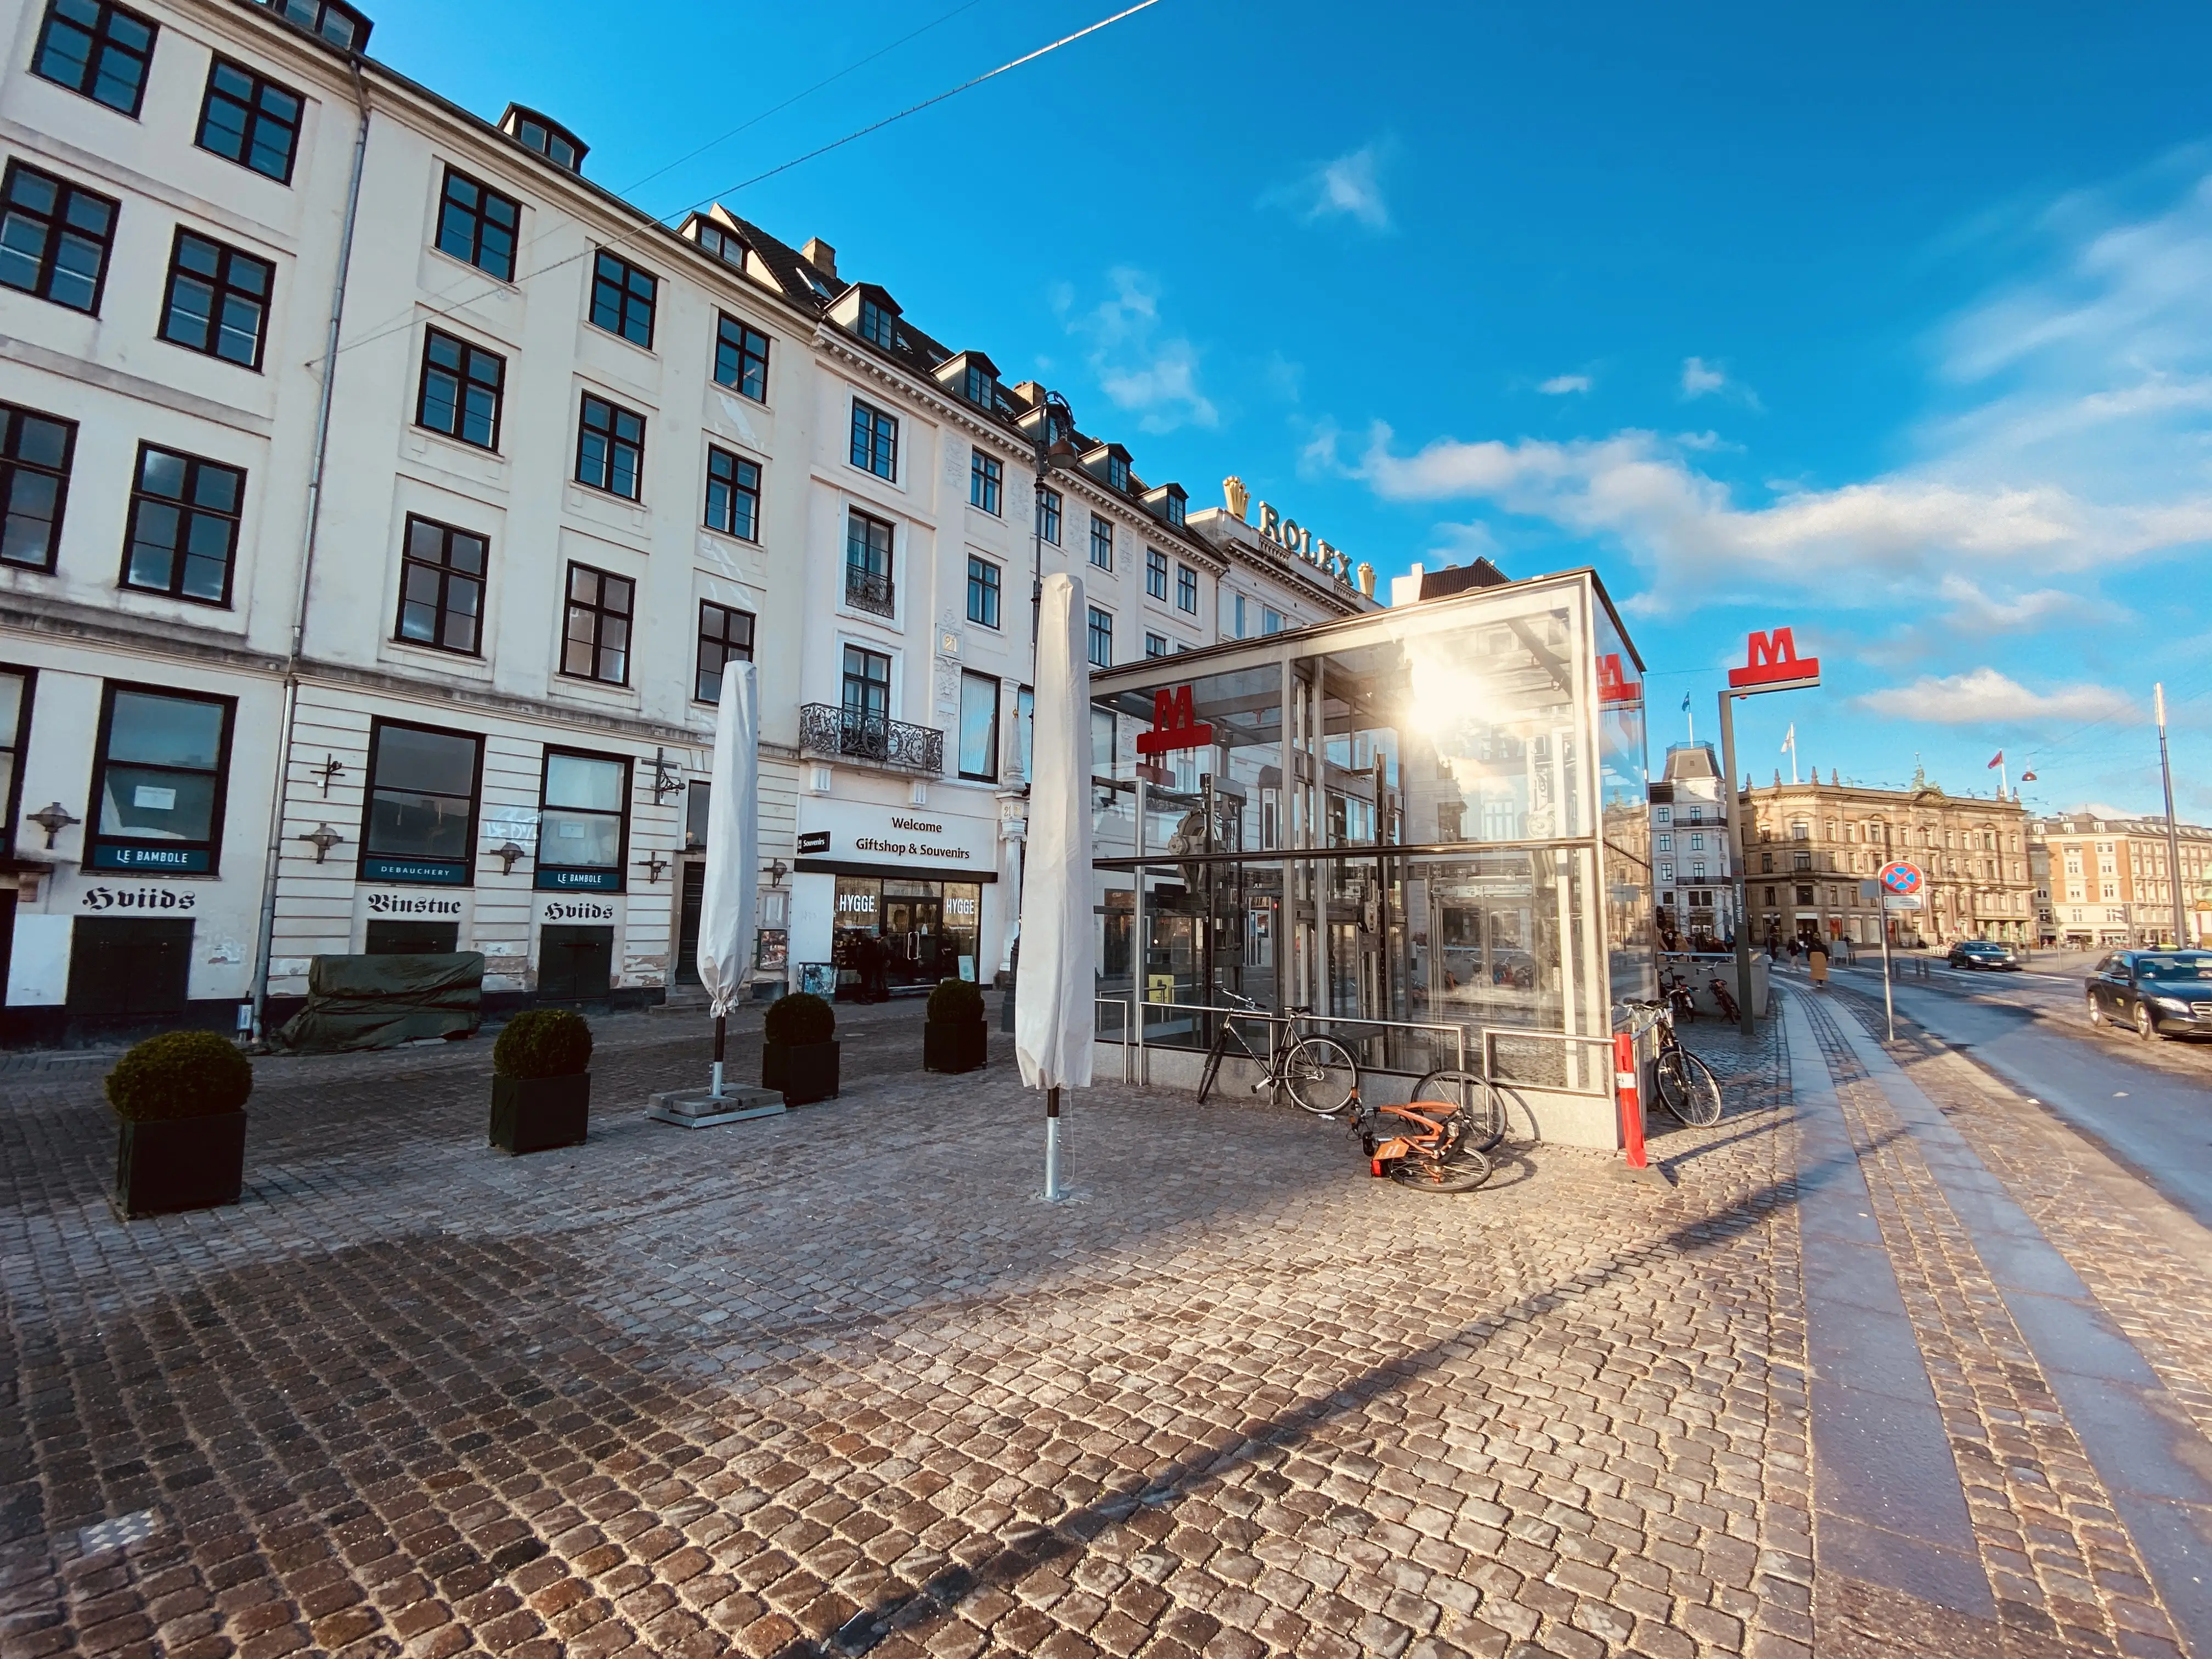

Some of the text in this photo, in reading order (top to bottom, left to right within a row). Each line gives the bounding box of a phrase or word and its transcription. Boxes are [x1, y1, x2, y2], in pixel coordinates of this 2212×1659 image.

[1260, 501, 1353, 586] ROLEX
[945, 636, 957, 652] 21
[891, 816, 942, 833] Welcome
[803, 838, 825, 847] Souvenirs
[855, 837, 970, 859] Giftshop & Souvenirs
[117, 850, 131, 863] LE
[137, 851, 188, 863] BAMBOLE
[381, 866, 450, 876] DEBAUCHERY
[557, 873, 602, 884] LE BAMBOLE
[82, 887, 196, 914] Hviids
[839, 894, 878, 913] HYGGE.
[544, 902, 613, 923] Hviids
